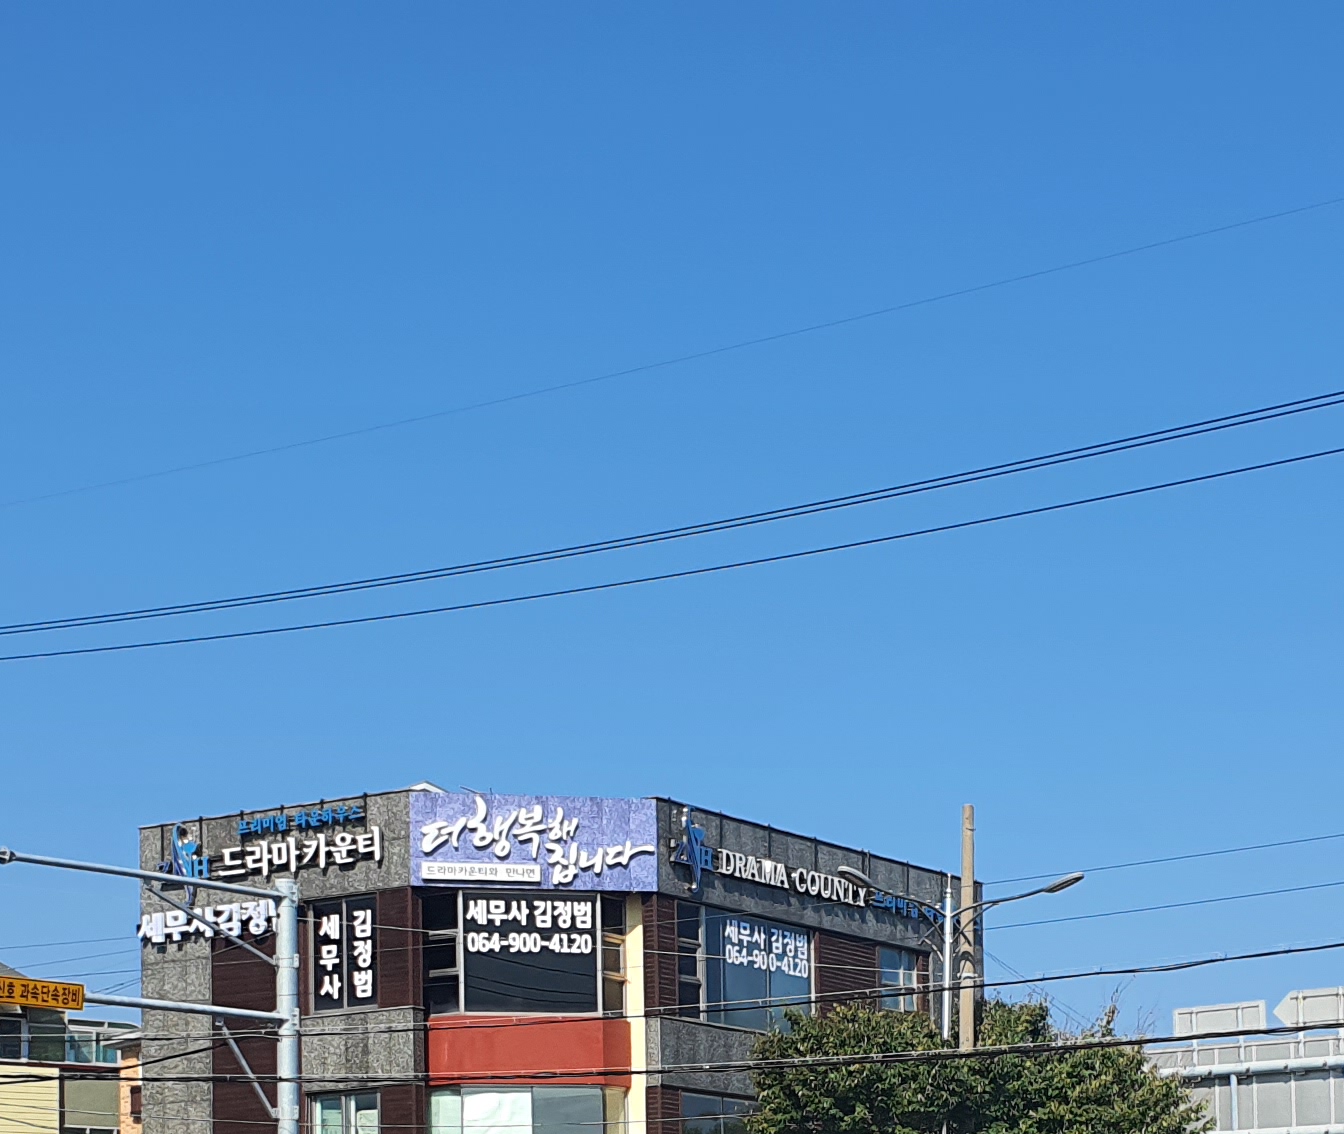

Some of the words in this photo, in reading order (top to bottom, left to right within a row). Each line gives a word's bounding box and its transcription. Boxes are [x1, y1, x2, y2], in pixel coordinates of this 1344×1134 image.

[237, 813, 288, 836] 프리미엄
[294, 804, 364, 830] 타운하우스
[218, 825, 383, 877] 드라마카운티
[426, 865, 498, 877] 드라마카운티와
[505, 867, 536, 878] 만나면
[543, 841, 655, 884] 집니다
[718, 848, 789, 889] DRAMA
[792, 866, 868, 907] COUNTY
[137, 899, 277, 943] 세무사김정
[466, 899, 529, 926] 세무사
[533, 900, 593, 929] 김정범
[318, 913, 342, 1000] 세무사
[352, 909, 373, 999] 김정범
[466, 932, 593, 954] 064-900-4120
[724, 919, 766, 950] 세무사
[770, 928, 808, 960] 김정범
[725, 944, 809, 978] 064-900-4120
[20, 983, 81, 1006] 과속단속장비
